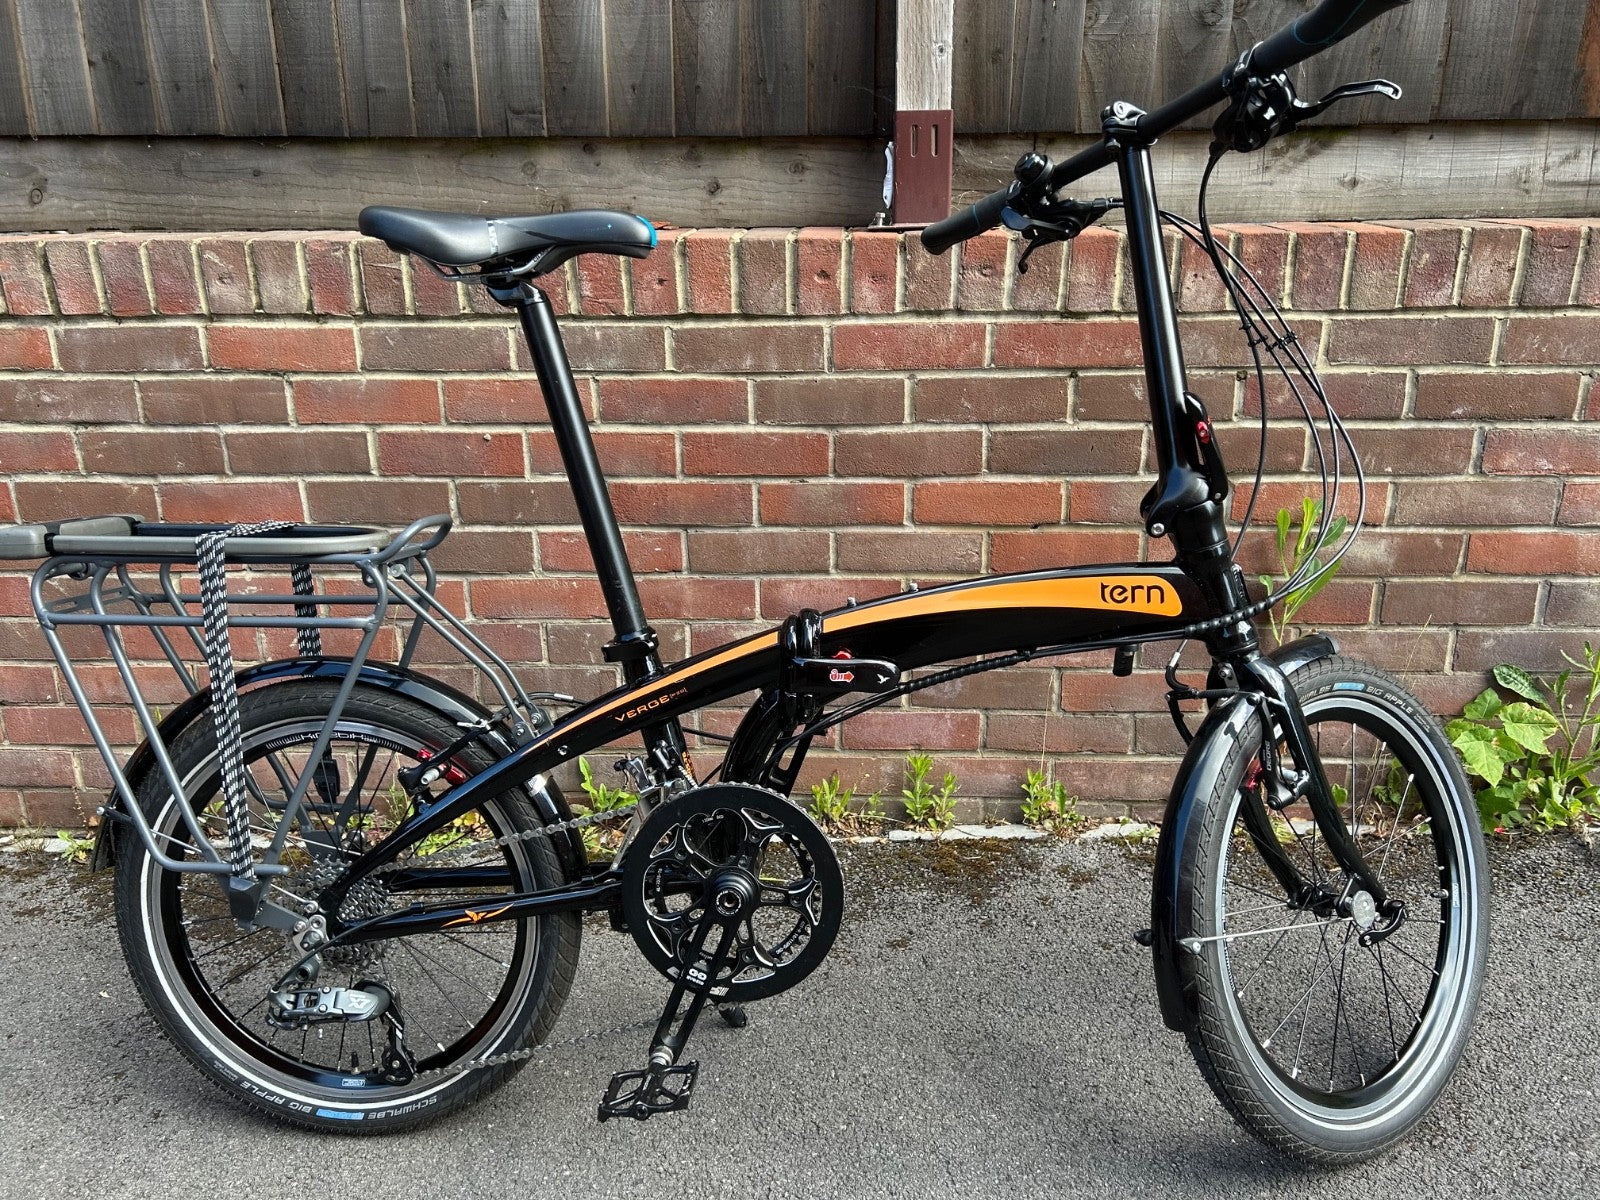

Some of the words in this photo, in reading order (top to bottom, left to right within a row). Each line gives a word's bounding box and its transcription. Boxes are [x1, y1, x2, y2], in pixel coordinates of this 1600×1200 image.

[1100, 581, 1165, 604] tern
[614, 694, 670, 722] VERGE
[1366, 685, 1384, 696] BIG
[1383, 692, 1415, 714] APPLE
[240, 1081, 286, 1105] APPLE
[288, 1102, 313, 1113] BIG
[367, 1095, 438, 1120] SCHWALBE
